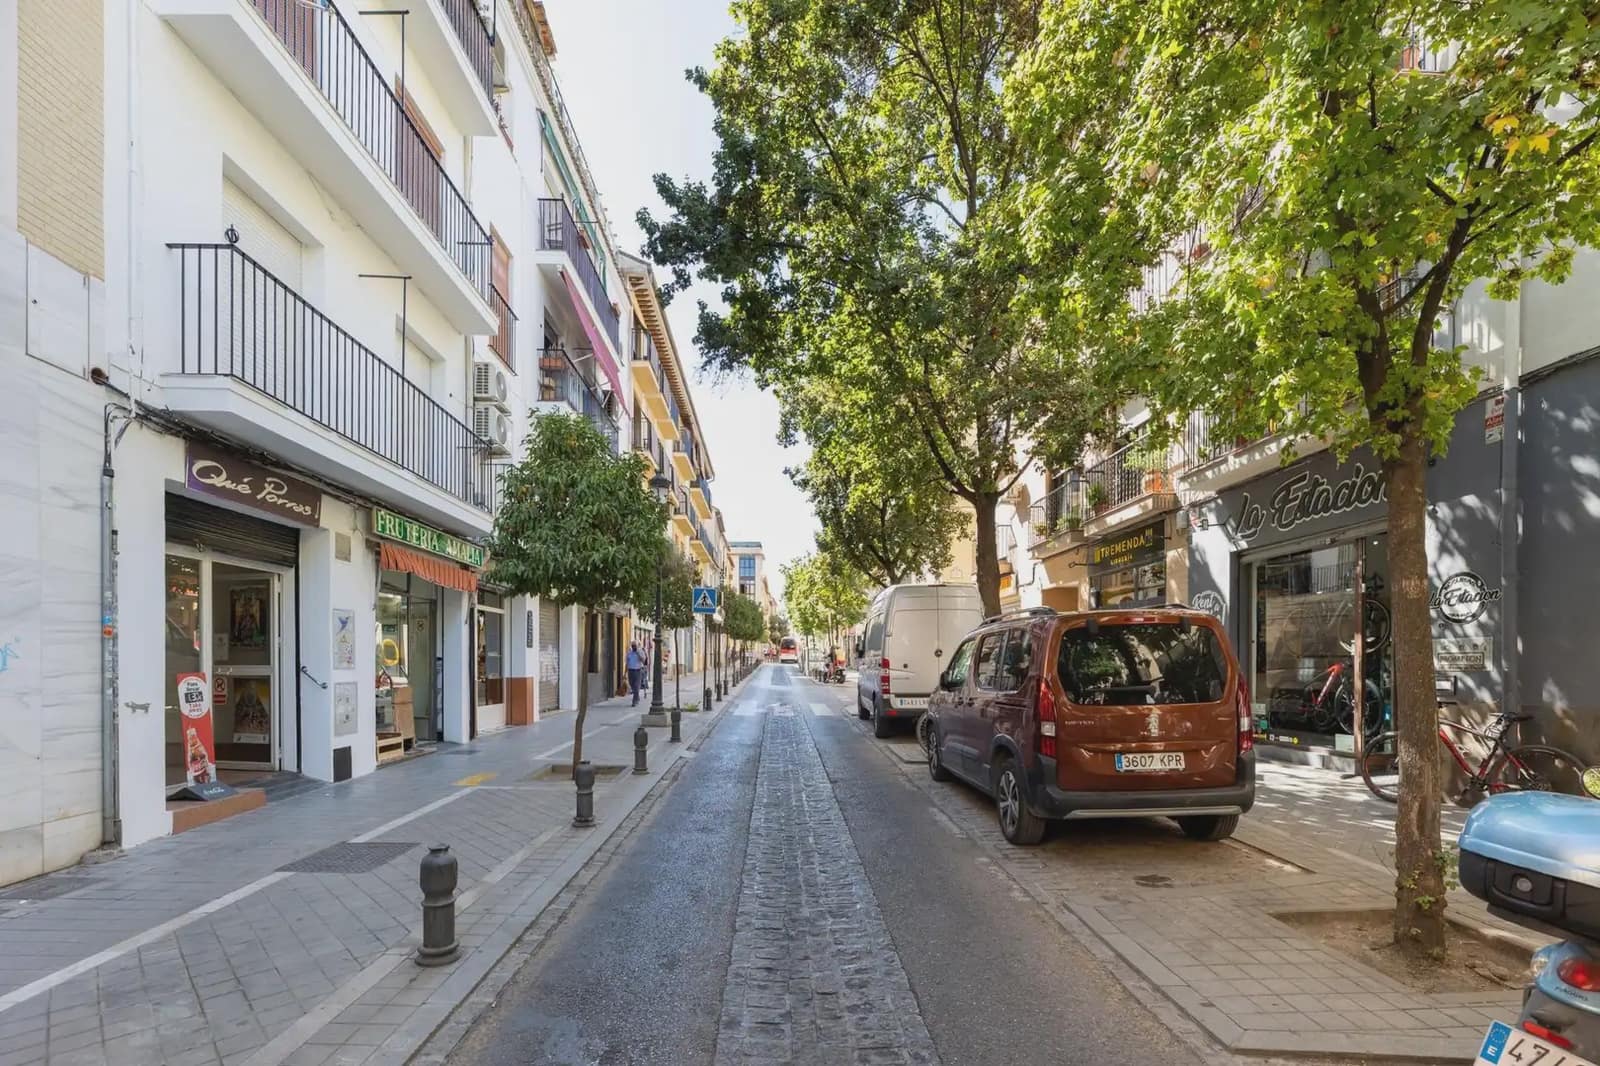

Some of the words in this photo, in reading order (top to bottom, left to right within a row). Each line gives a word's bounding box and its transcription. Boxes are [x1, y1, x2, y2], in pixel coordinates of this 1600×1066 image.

[191, 460, 253, 494] Qué
[377, 510, 439, 552] FRUTERIA
[1235, 492, 1266, 541] La
[1100, 535, 1145, 558] TREMENDA
[1123, 755, 1155, 768] 3607
[1159, 754, 1184, 768] KPR
